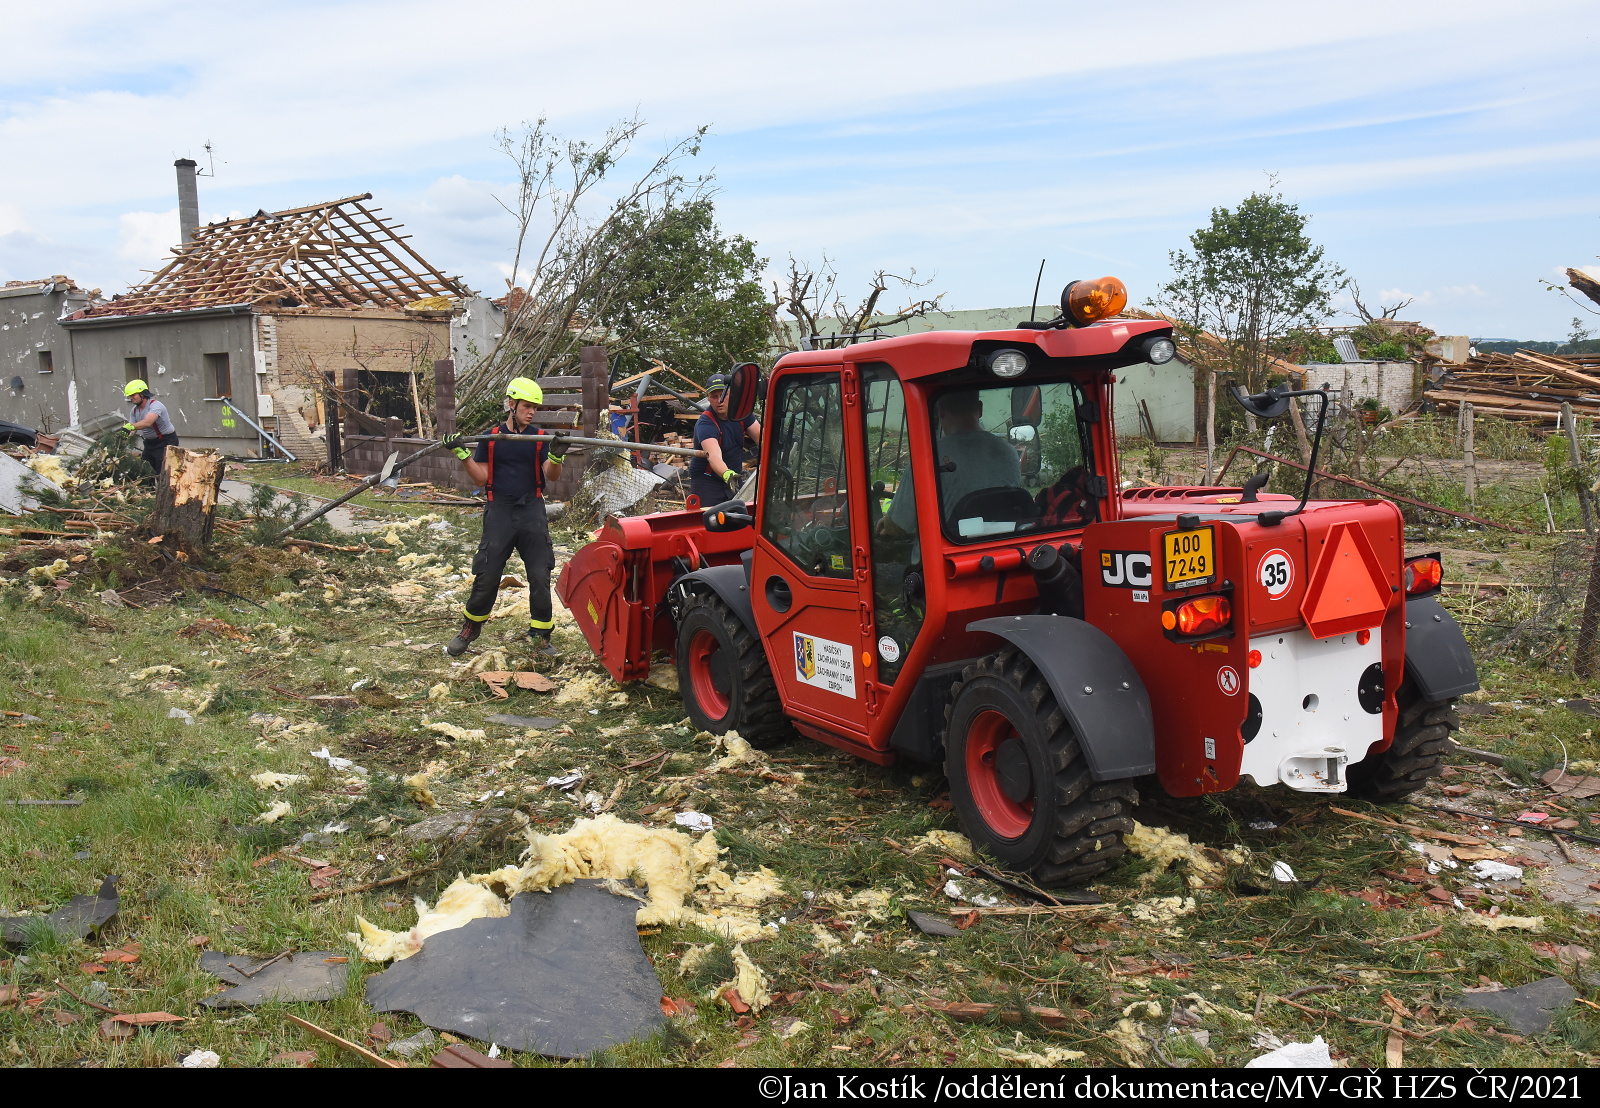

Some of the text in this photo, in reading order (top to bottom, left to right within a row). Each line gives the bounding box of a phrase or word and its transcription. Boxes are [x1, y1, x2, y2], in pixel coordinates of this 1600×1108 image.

[222, 405, 232, 416] OK
[1168, 555, 1206, 579] 7249
[1265, 561, 1287, 587] 35
